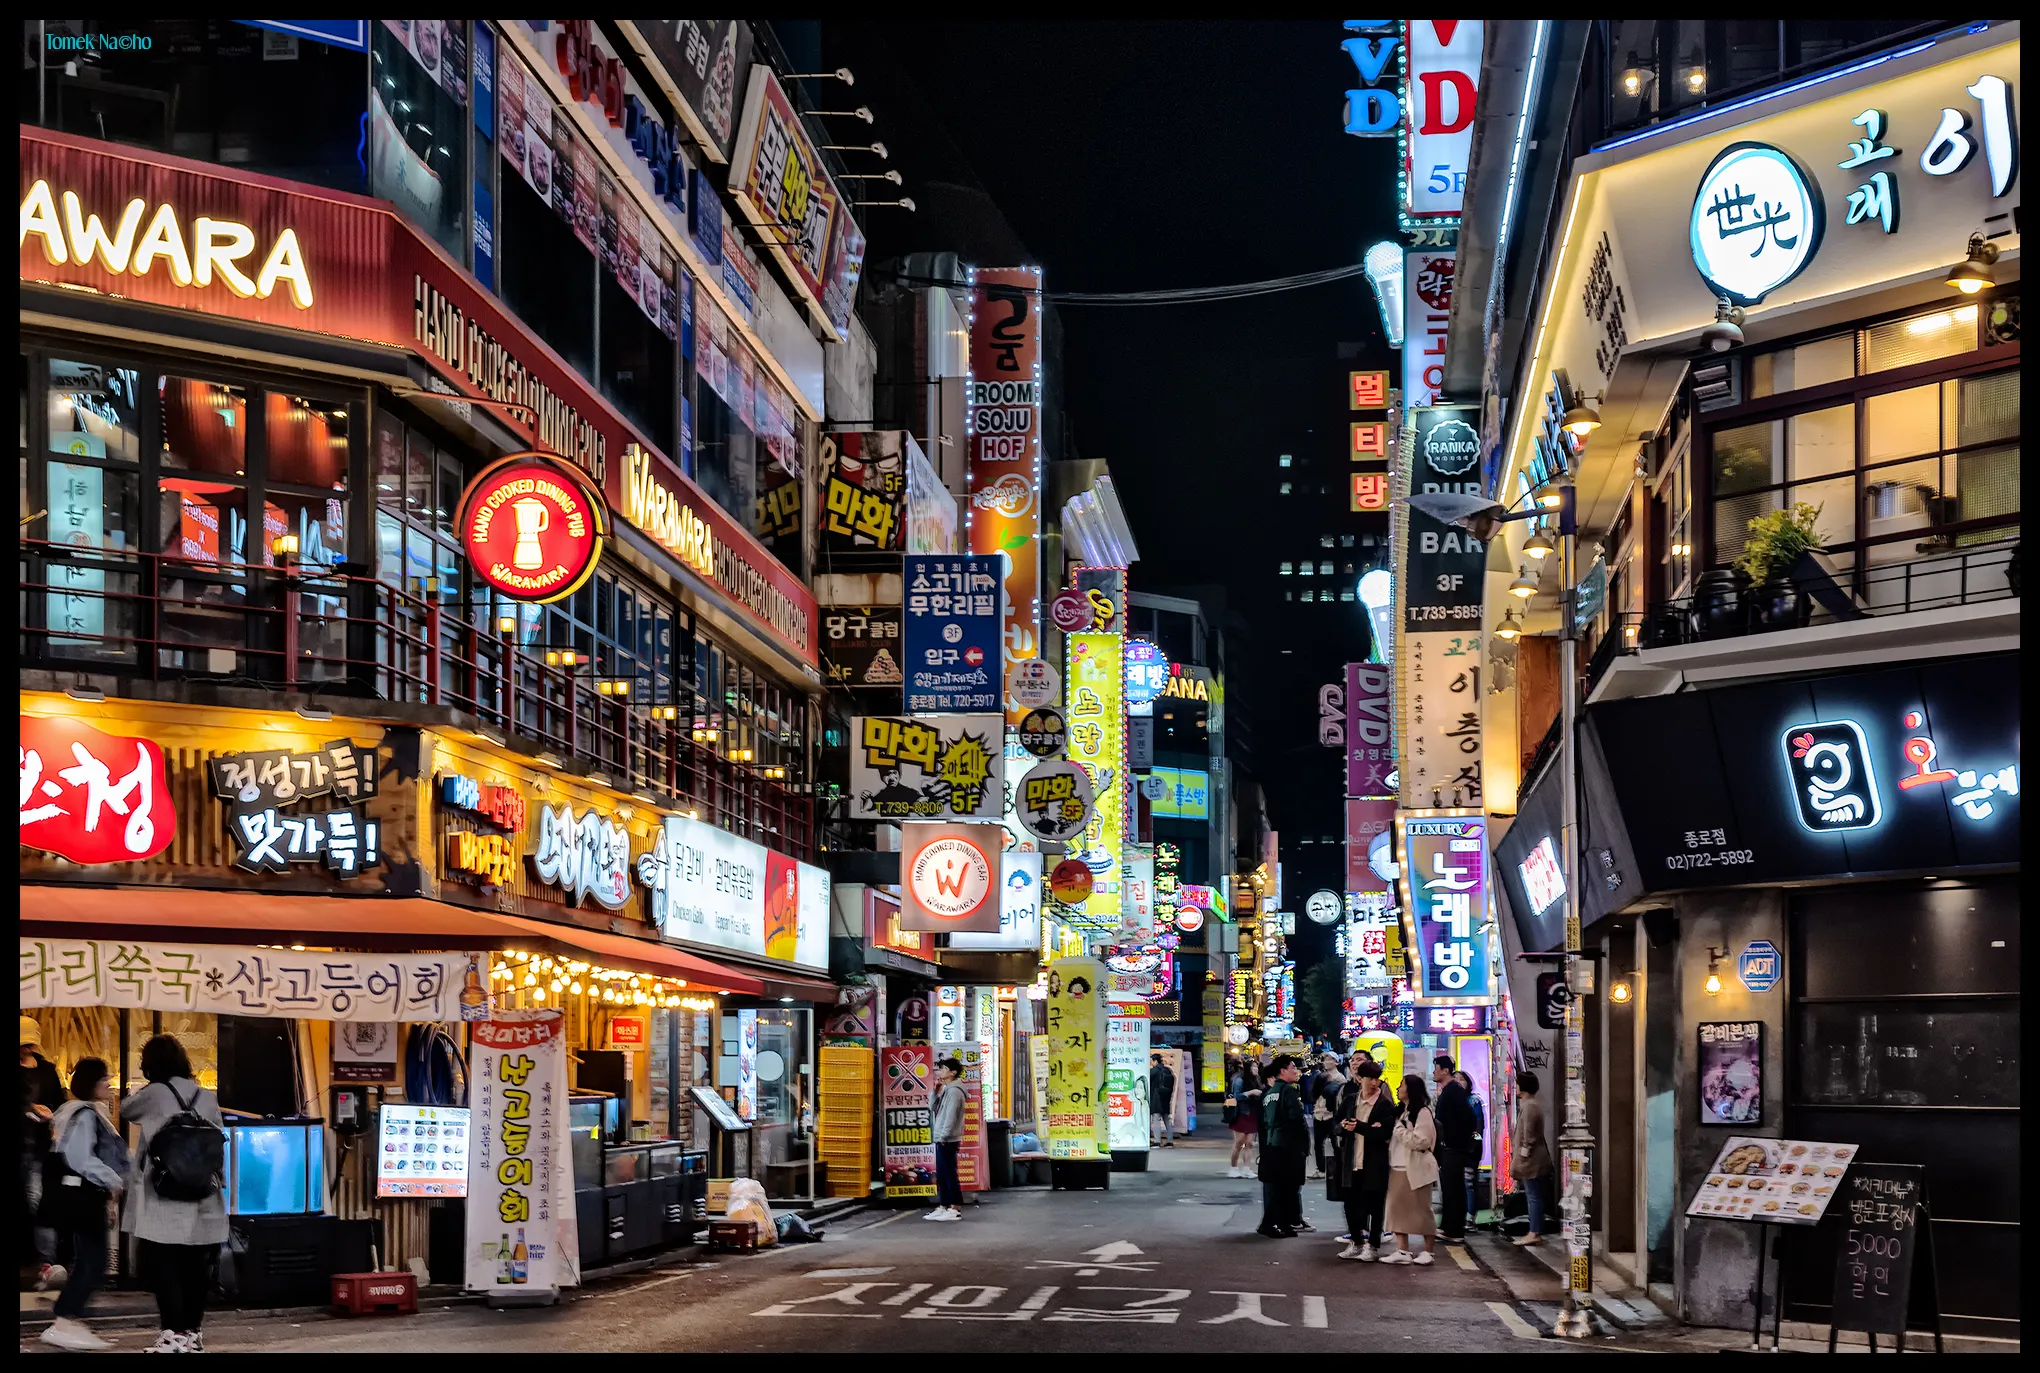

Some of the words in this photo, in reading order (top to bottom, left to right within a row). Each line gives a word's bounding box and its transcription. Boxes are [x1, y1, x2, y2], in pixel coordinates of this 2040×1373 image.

[1341, 20, 1399, 136] VD
[20, 179, 314, 310] AWARA
[414, 274, 465, 370] HAND
[974, 381, 1033, 406] ROOM
[976, 408, 1031, 433] SOJU
[981, 436, 1025, 461] HOF
[1354, 372, 1389, 509] 멀티방
[1430, 441, 1475, 454] RANKA
[884, 473, 903, 492] 5F
[472, 506, 494, 543] HAND
[485, 479, 535, 509] COOKED
[535, 479, 576, 514] DINING
[566, 512, 585, 538] PUB
[622, 444, 712, 576] WARAWARA
[827, 474, 894, 550] 만화
[1420, 531, 1483, 554] BAR
[490, 563, 569, 589] WARAWARA
[910, 573, 970, 594] 소고기
[1436, 574, 1464, 592] 3F
[908, 595, 995, 616] 무한리필
[826, 616, 899, 640] 당구클럽
[945, 628, 960, 639] 3F
[924, 649, 960, 666] 입구
[1014, 679, 1051, 692] 부동산
[1163, 676, 1208, 701] ANA
[908, 695, 936, 709] 종로점
[954, 694, 995, 707] 720-5917
[1358, 667, 1389, 746] DVD
[1319, 683, 1347, 748] DVD
[1022, 733, 1064, 745] 당구클럽
[1445, 665, 1482, 800] 이층집
[864, 718, 939, 776] 만화
[220, 744, 374, 802] 정성가득!
[1149, 778, 1162, 788] LP
[1363, 764, 1383, 787] 美
[950, 792, 981, 814] 5F
[1026, 774, 1075, 810] 만화
[1065, 803, 1080, 816] 5F
[238, 808, 377, 871] 맛가득!
[1407, 823, 1466, 836] LUXURY
[1683, 828, 1727, 849] 종로점
[675, 842, 705, 885] 닭갈비
[715, 856, 755, 900] 철판볶음밥
[915, 858, 928, 881] HAND
[925, 842, 955, 859] COOKED
[956, 843, 982, 866] DINING
[1667, 849, 1754, 870] 02)722-5892
[1157, 847, 1177, 921] 노래방
[926, 896, 976, 912] WARAWARA
[1422, 852, 1480, 990] 노래방
[1744, 958, 1774, 975] ADT
[941, 988, 957, 999] 2F
[888, 1111, 930, 1126] 10분당
[887, 1127, 932, 1144] 1000원
[1850, 1200, 1916, 1231] 방문포장시
[1848, 1229, 1901, 1259] 5000
[1848, 1258, 1889, 1298] 할인
[750, 1282, 1329, 1329] 진입금지
